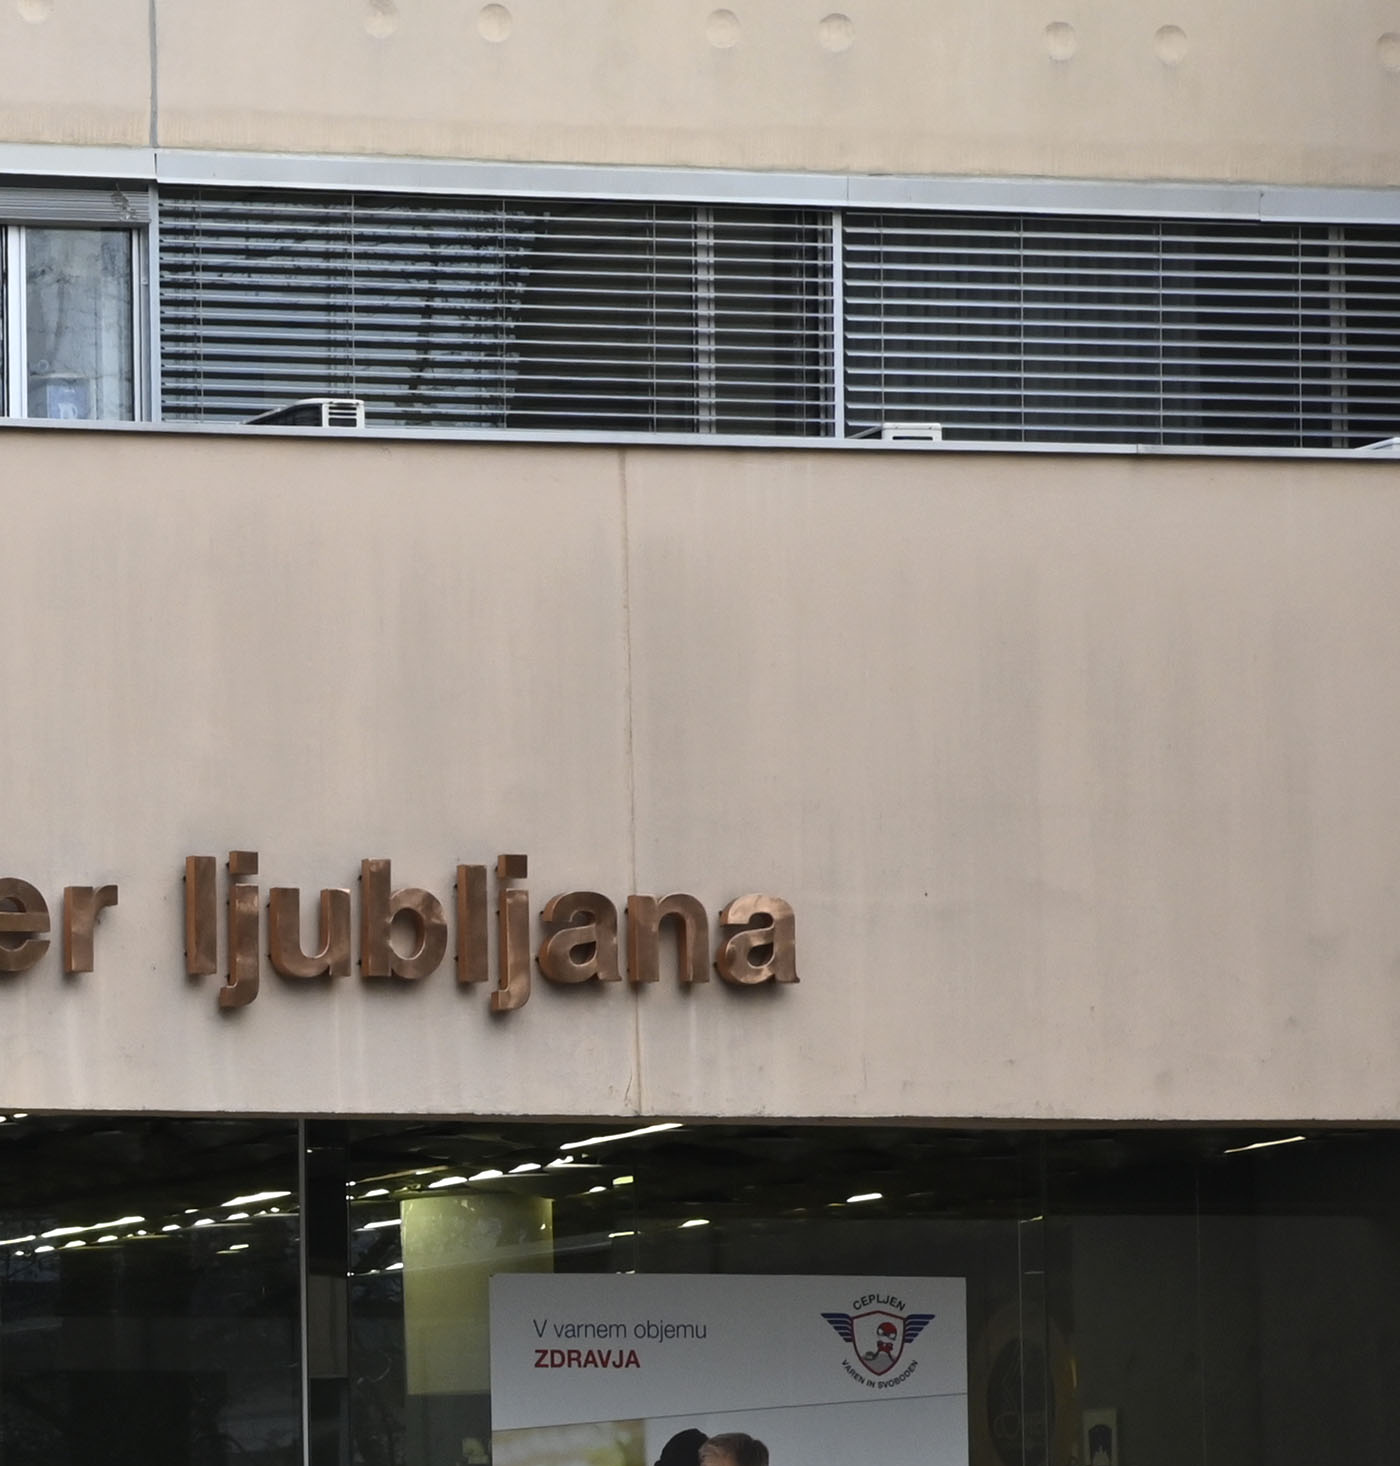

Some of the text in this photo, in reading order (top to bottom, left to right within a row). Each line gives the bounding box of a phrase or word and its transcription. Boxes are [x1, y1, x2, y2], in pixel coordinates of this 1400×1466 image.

[183, 850, 801, 1015] ljubljana
[852, 1294, 906, 1311] CEPLJEN
[533, 1319, 708, 1344] V varnem objemu
[534, 1349, 641, 1369] ZDRAVJA
[841, 1360, 865, 1384] VAREN
[878, 1360, 918, 1389] SVOBODEN
